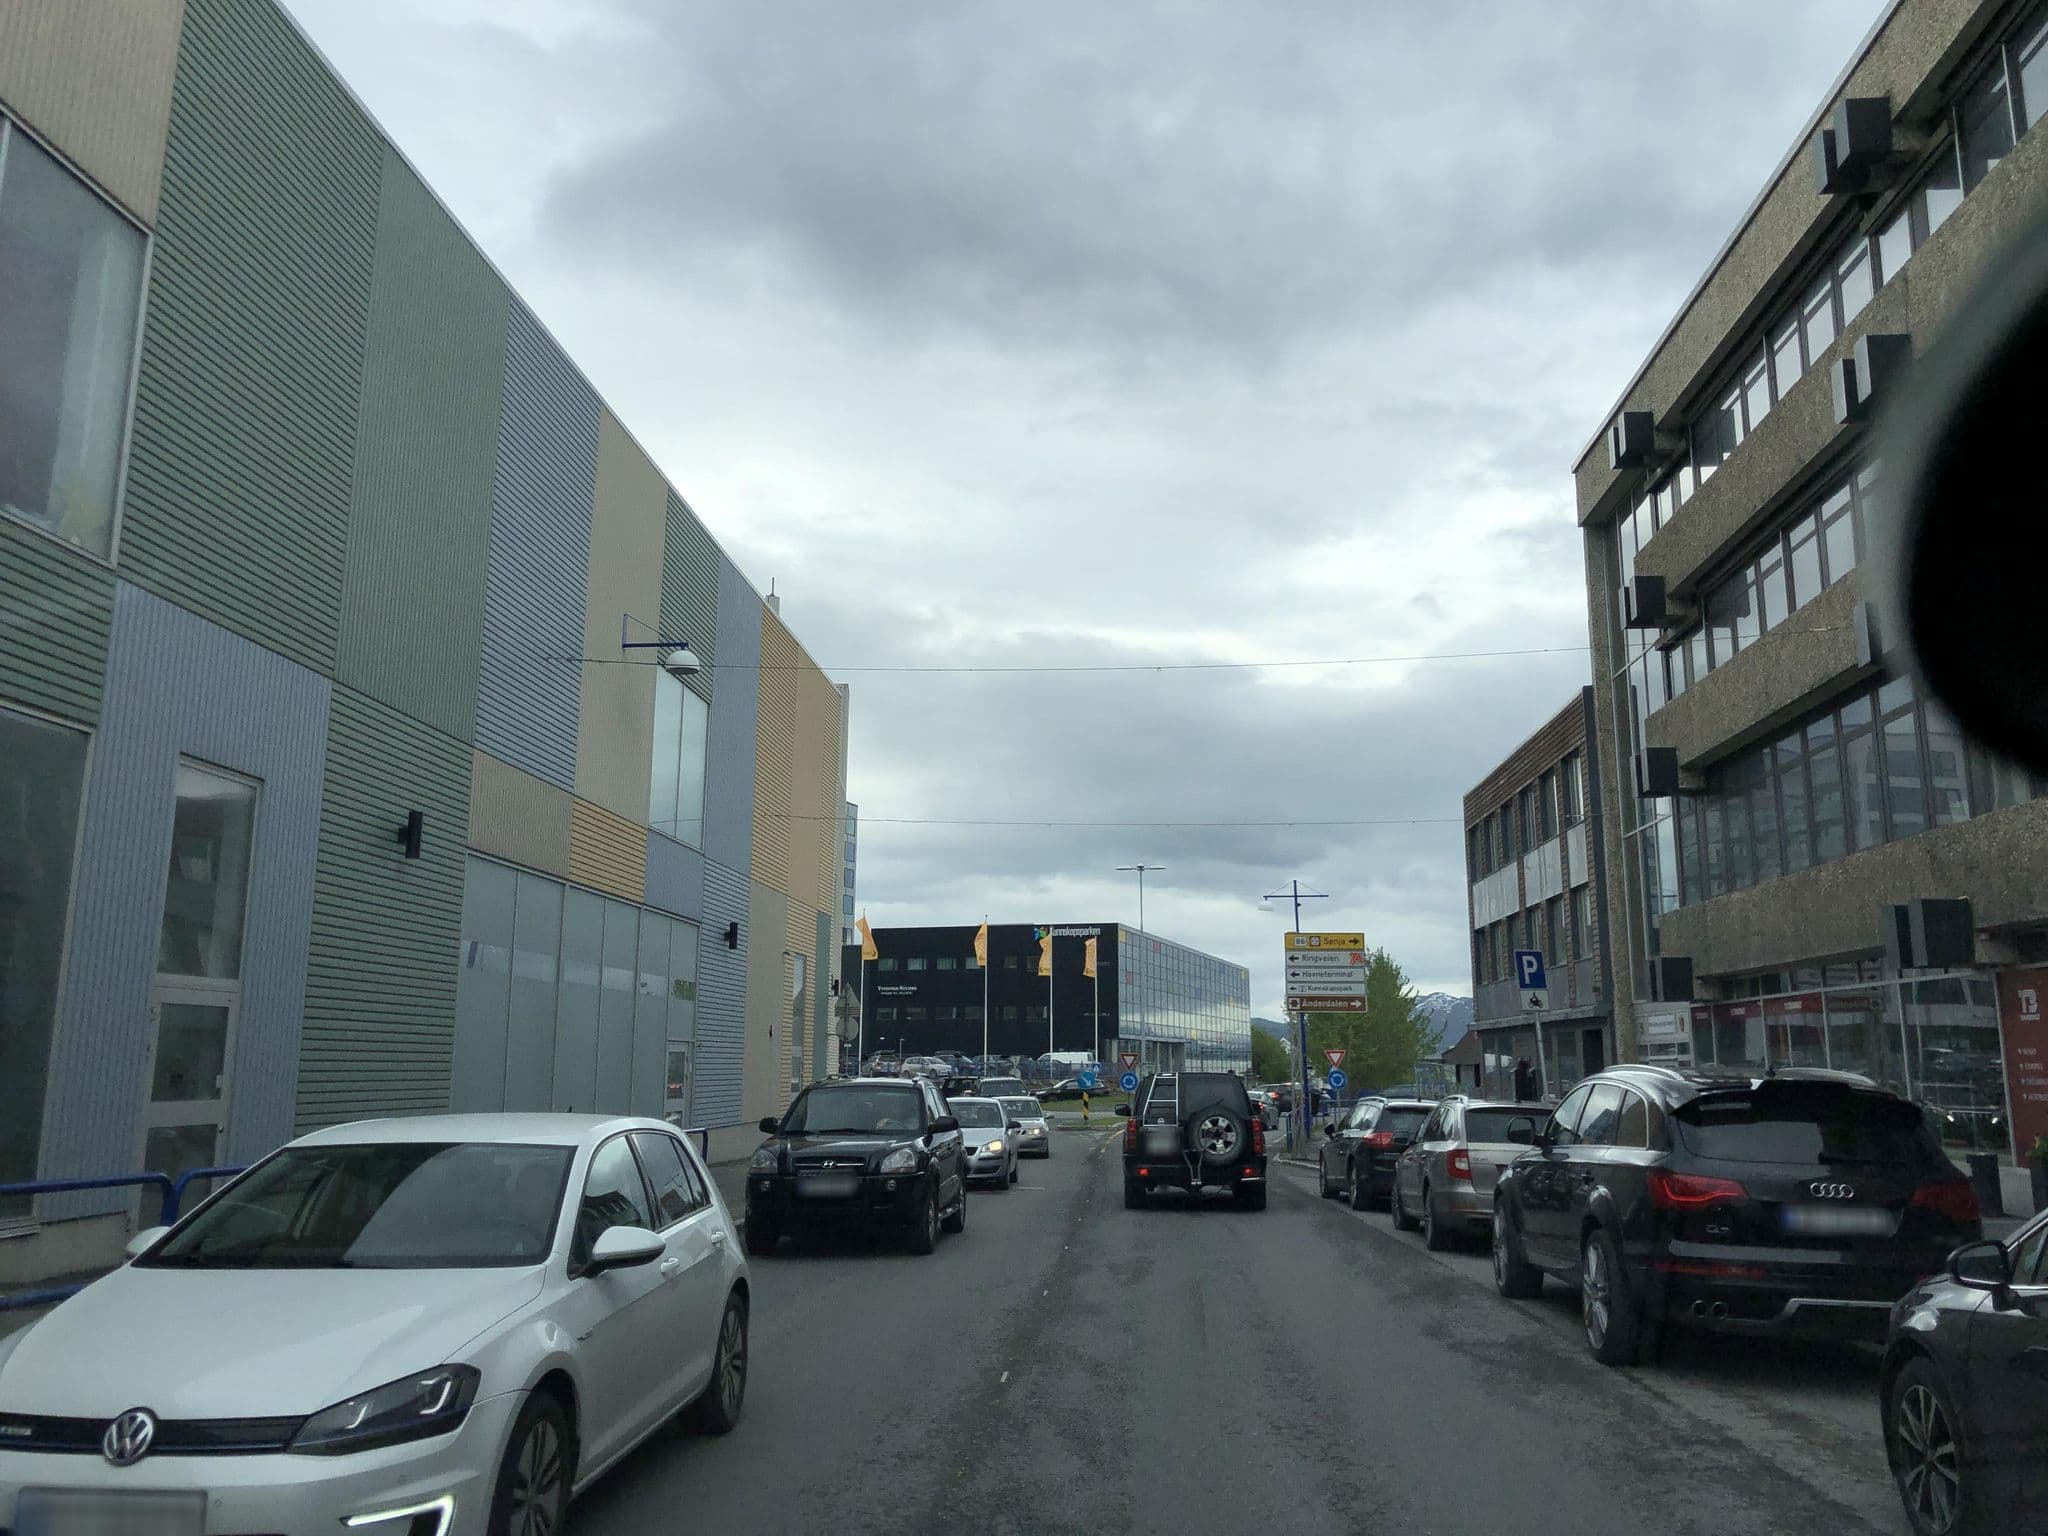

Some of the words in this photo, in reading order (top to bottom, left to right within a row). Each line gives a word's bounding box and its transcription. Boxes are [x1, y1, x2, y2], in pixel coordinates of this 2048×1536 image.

[1323, 937, 1346, 946] Senja
[1301, 954, 1339, 963] Ringveien
[1302, 970, 1353, 978] Havneterminal
[1521, 955, 1538, 985] P
